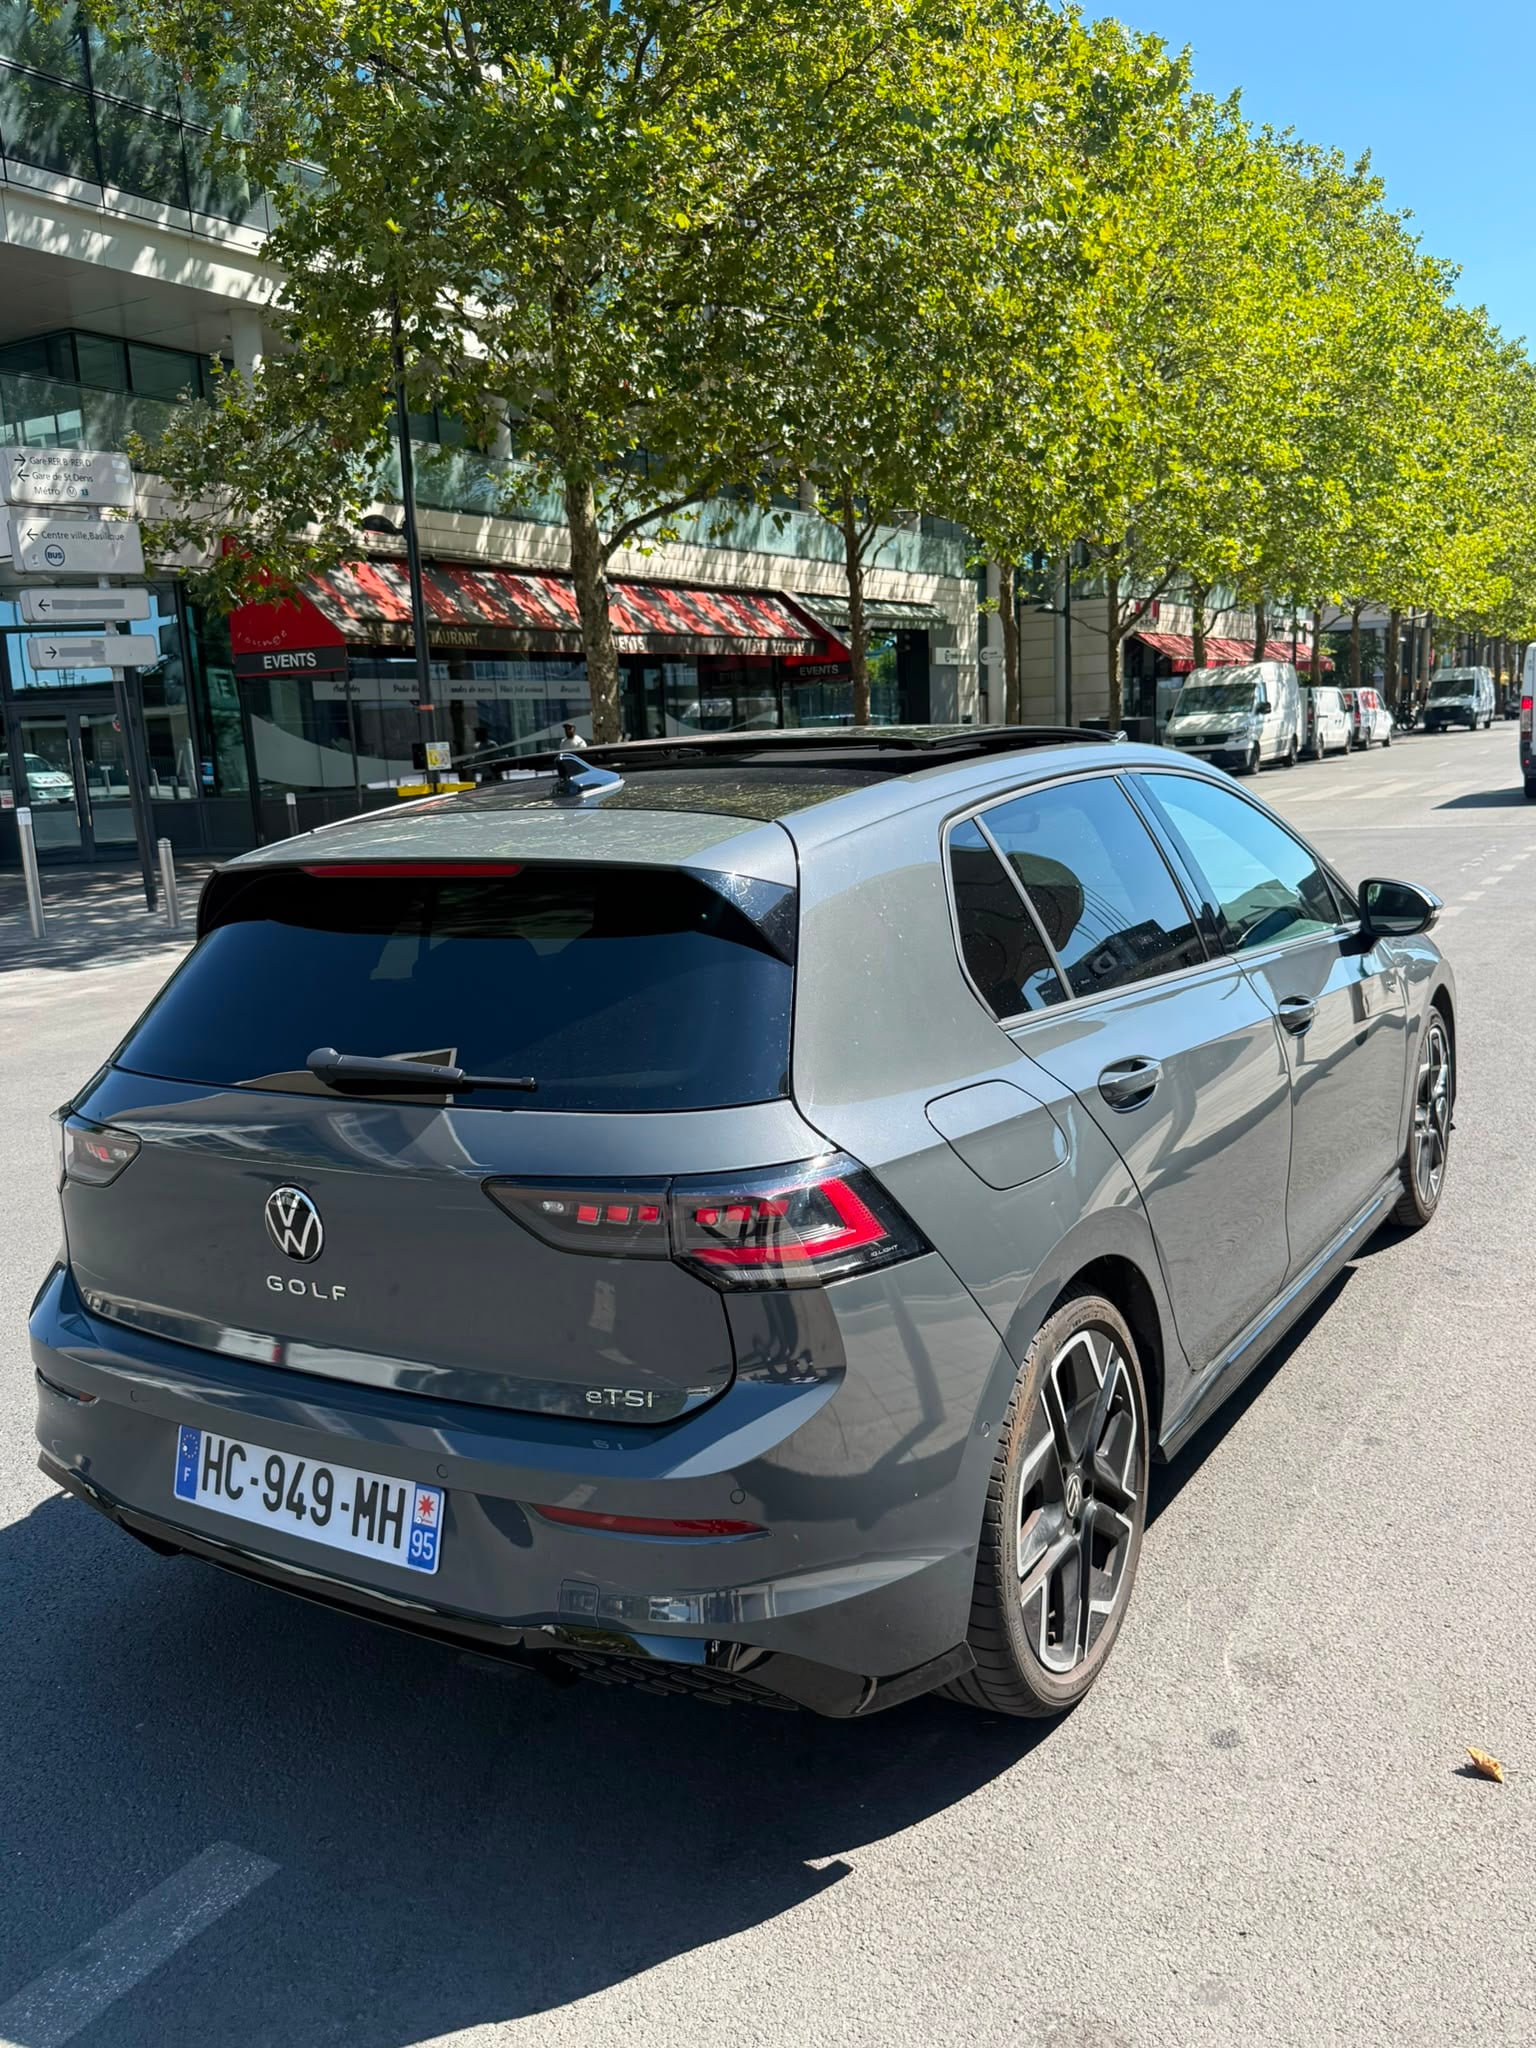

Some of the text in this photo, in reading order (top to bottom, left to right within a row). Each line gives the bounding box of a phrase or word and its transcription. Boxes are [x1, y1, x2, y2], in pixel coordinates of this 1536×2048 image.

[29, 456, 92, 468] Gare RER B RER D
[31, 471, 51, 480] Gare
[53, 473, 63, 481] de
[34, 486, 61, 496] Métro
[41, 530, 69, 540] Centre
[46, 551, 63, 560] BUS
[407, 624, 479, 646] RTAURANT
[263, 651, 317, 670] EVENTS
[799, 663, 839, 677] EVENTS
[266, 1275, 347, 1301] GOLF
[585, 1388, 654, 1409] eTSI
[183, 1466, 192, 1483] F
[201, 1435, 407, 1550] HC-949-MH
[410, 1529, 435, 1561] 95
